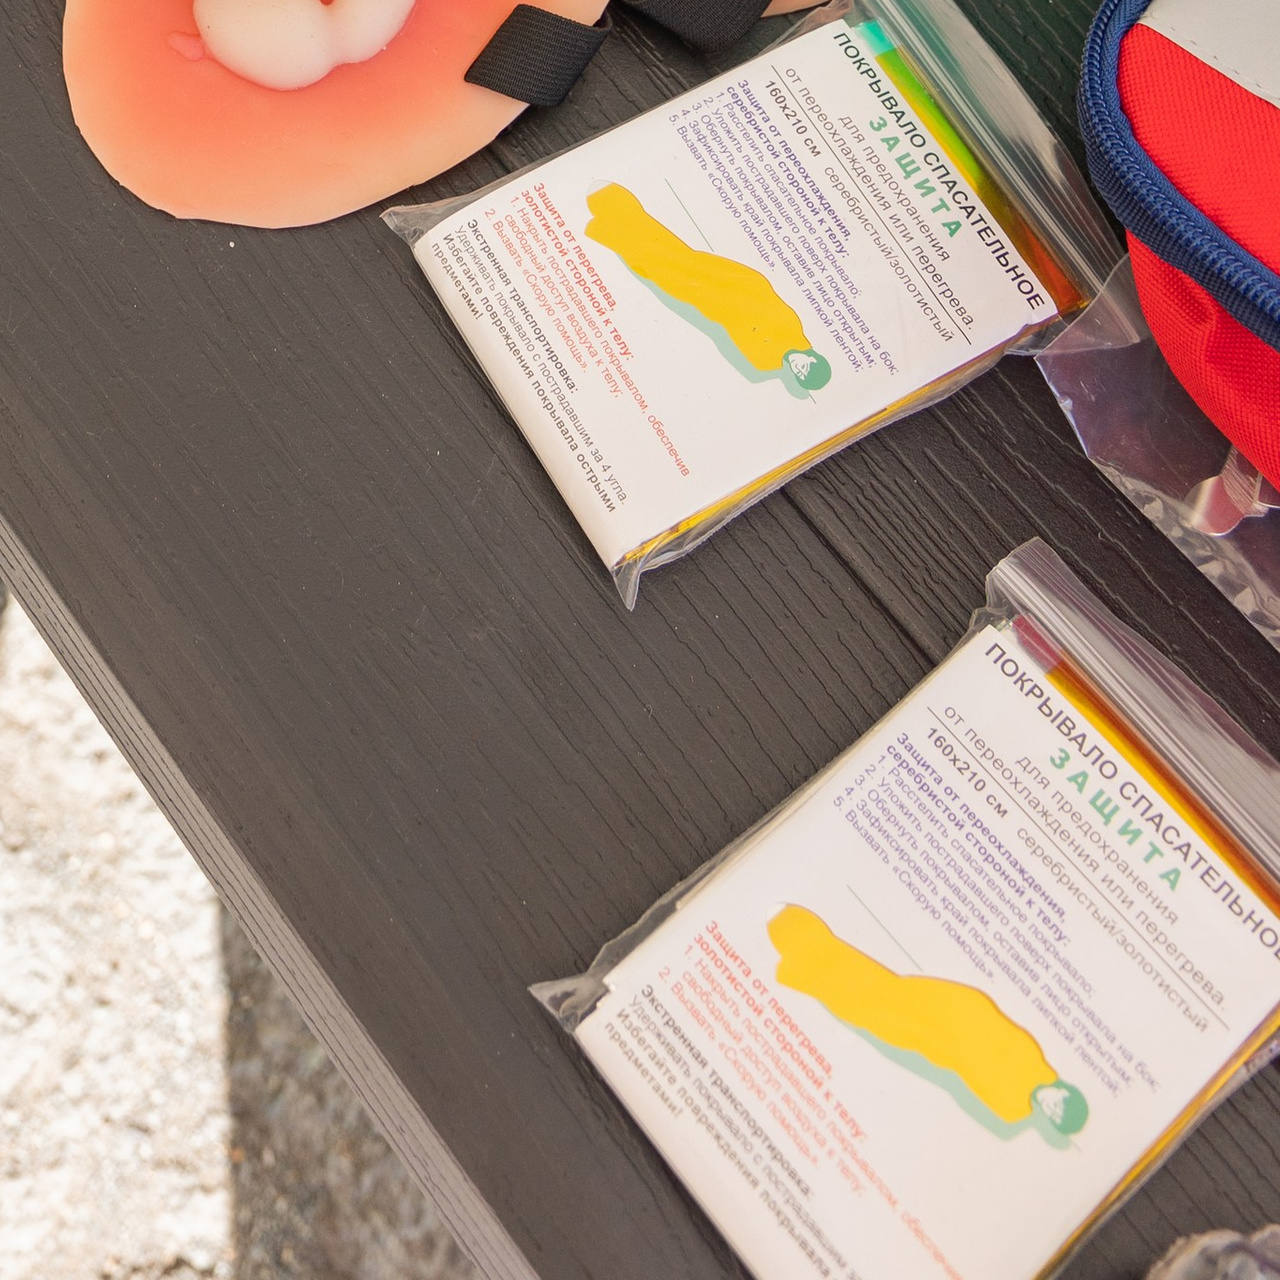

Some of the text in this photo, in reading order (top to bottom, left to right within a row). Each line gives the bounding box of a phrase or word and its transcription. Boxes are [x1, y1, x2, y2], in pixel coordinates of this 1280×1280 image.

[532, 181, 617, 312] Защита от перегрева,
[667, 113, 776, 272] 5. Вызвать «Скорую помощь».
[680, 108, 864, 373] 4. Зафиксировать край покрывала липкой лентой;
[690, 101, 877, 369] 3. Обернуть покрывалом, оставив лицо открытым;
[701, 95, 899, 377] 2. Уложить пострадавшего поверх покрывала на бок;
[715, 91, 862, 300] 1. Расстелить спасательное покрывало;
[725, 85, 850, 259] серебристой стороной к телу:
[736, 78, 851, 242] Защита от переохлаждения,
[763, 79, 955, 342] 160x210 см серебристый/золотистый
[784, 67, 974, 331] от переохлаждения или перегрева.
[832, 31, 1046, 311] ПОКРЫВАЛО СПАСАТЕЛЬНОЕ
[836, 115, 951, 262] для предохранения
[868, 115, 963, 239] ЗАЩИТА
[430, 241, 484, 321] предметами!
[453, 224, 627, 506] Удерживать покрывало с пострадавшим за 4 угла.
[466, 218, 579, 395] Экстренная транспортировка:
[483, 207, 588, 374] 2. Вызвать «Скорую помощь».
[503, 213, 624, 399] свободный доступ воздуха к телу;
[509, 195, 690, 477] 1. Накрыть пострадавшего покрывалом, обеспечив
[520, 188, 634, 361] золотистой стороной к телу:
[441, 232, 616, 513] Избегайте повреждения покрывала острыми
[983, 641, 1119, 781] ПОКРЫВАЛО
[831, 794, 846, 812] 5.
[843, 807, 890, 865] Вызвать
[891, 864, 942, 921] «Скорую
[843, 786, 855, 802] 4.
[854, 797, 939, 897] Зафиксировать
[938, 894, 970, 929] край
[966, 925, 1032, 999] покрывала
[1029, 996, 1076, 1046] липкой
[853, 773, 866, 792] 3.
[866, 788, 919, 852] Обернуть
[918, 848, 991, 933] покрывалом,
[991, 930, 1041, 984] оставив
[1038, 981, 1071, 1018] лицо
[863, 762, 877, 781] 2.
[875, 775, 923, 833] Уложить
[922, 830, 1010, 928] пострадавшего
[1008, 925, 1053, 974] поверх
[1050, 971, 1117, 1045] покрывала
[1115, 1043, 1134, 1065] на
[876, 753, 891, 770] 1.
[886, 765, 949, 840] Расстелить
[949, 837, 1028, 925] спасательное
[885, 744, 1071, 947] серебристой стороной к телу:
[895, 731, 1066, 924] Защита от переохлаждения,
[926, 726, 1209, 1033] 160x210 см серебристый/золотистый
[943, 705, 1225, 1011] от переохлаждения или перегрева.
[1013, 755, 1179, 927] для предохранения
[1048, 746, 1182, 893] ЗАЩИТА
